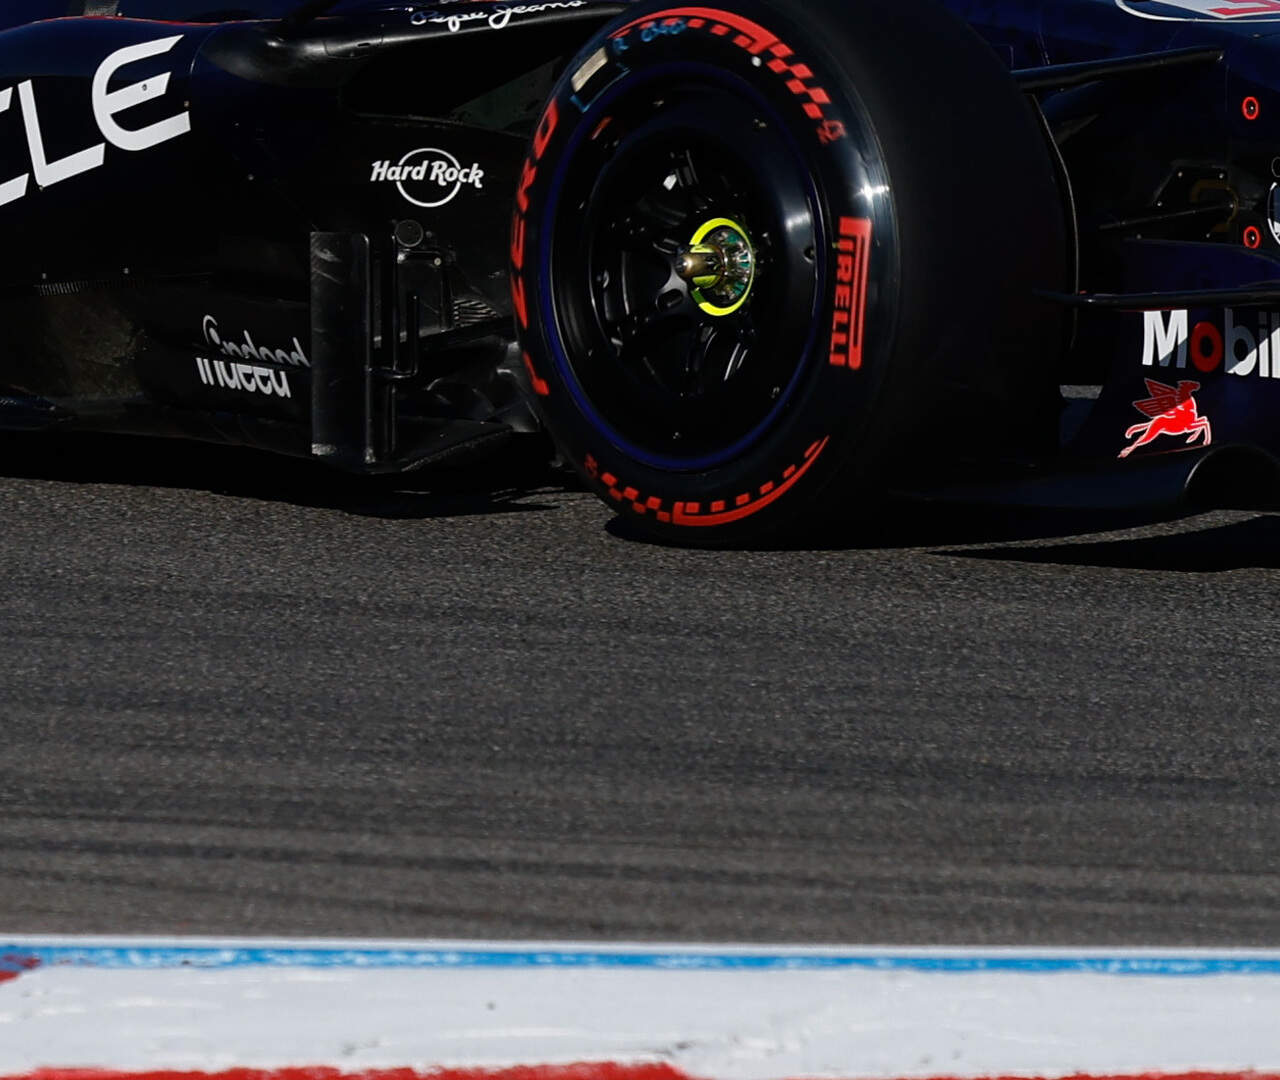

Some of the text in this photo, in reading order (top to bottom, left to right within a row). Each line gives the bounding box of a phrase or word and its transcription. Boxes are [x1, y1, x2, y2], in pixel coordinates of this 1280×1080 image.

[487, 0, 587, 30] Jeans
[370, 160, 484, 188] Hard Rock
[830, 217, 872, 369] PIRELLI
